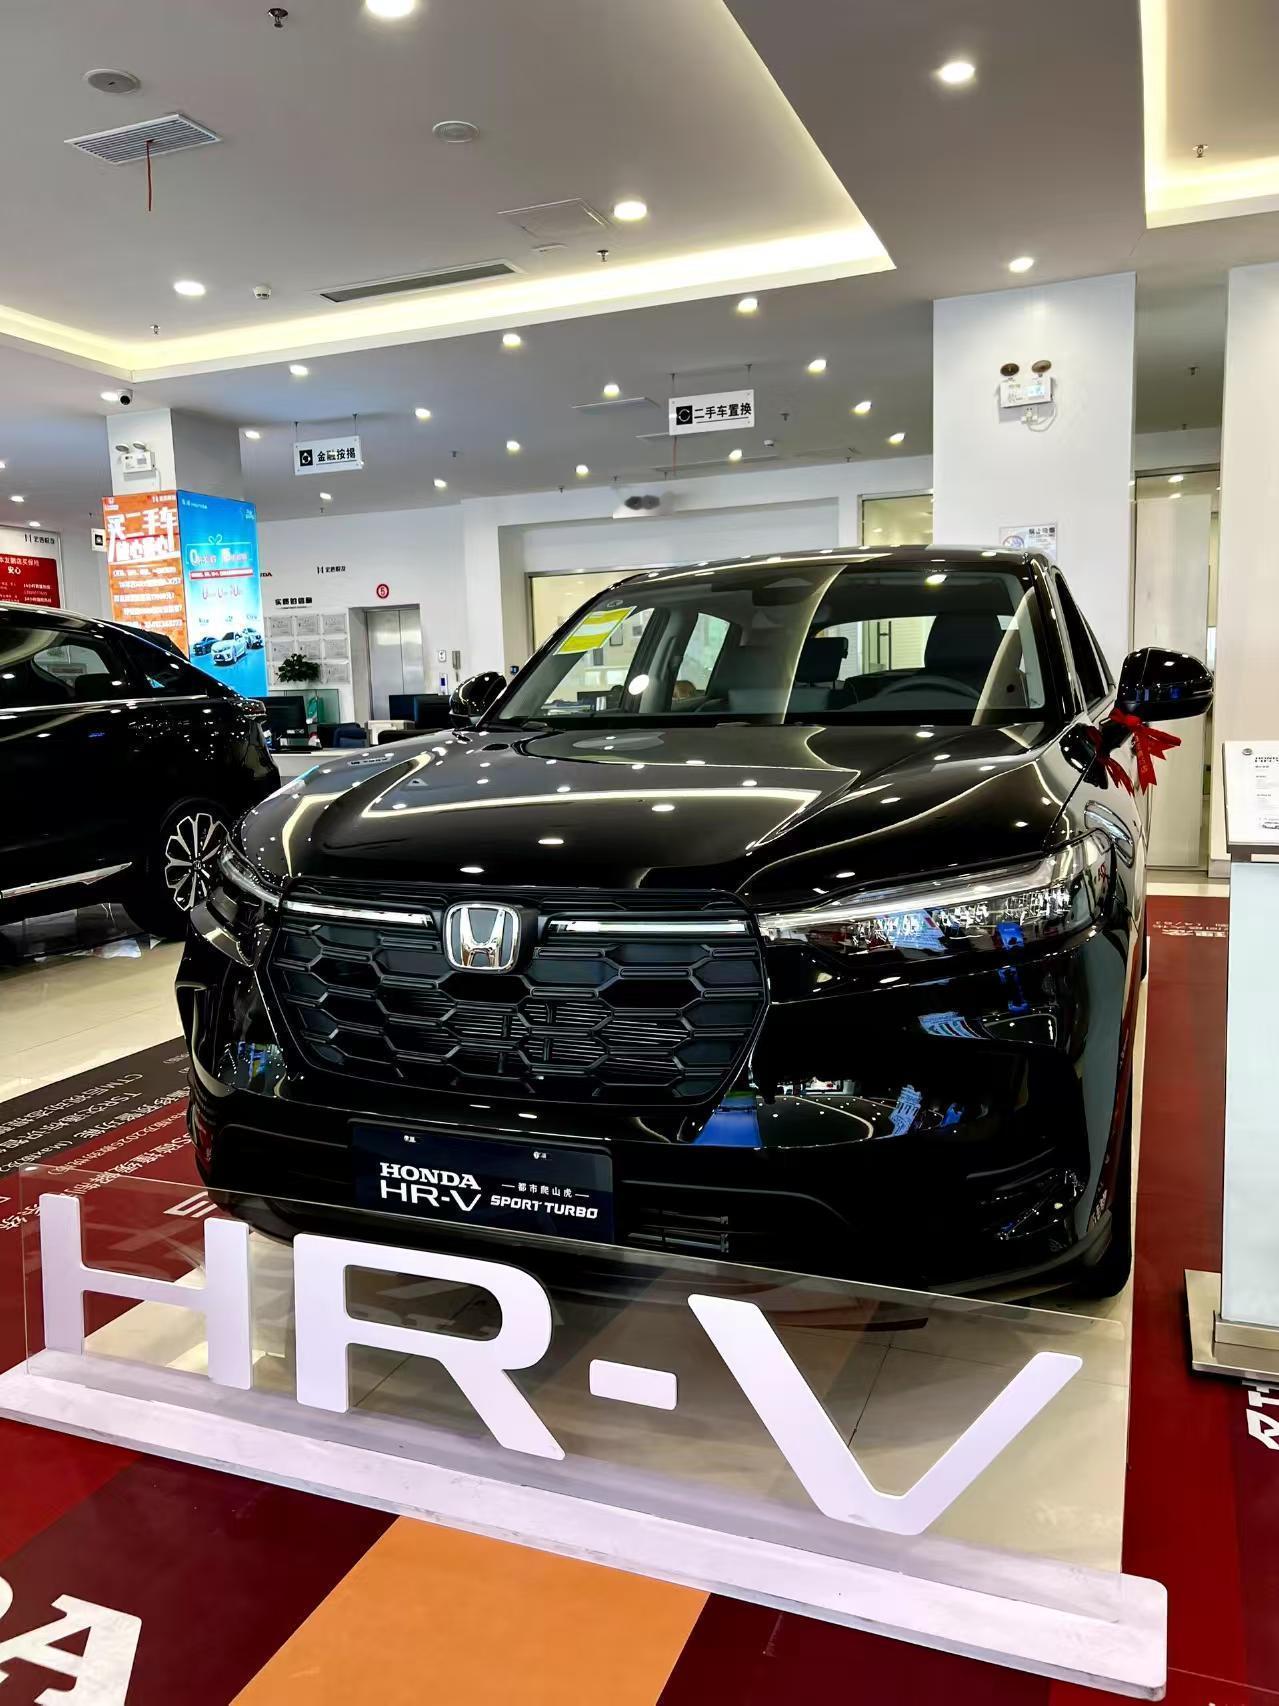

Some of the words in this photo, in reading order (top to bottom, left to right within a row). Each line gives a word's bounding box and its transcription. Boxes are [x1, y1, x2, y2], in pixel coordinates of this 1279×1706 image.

[694, 402, 752, 420] 二手车置换
[0, 1092, 142, 1152] TSR交通标识智
[380, 1162, 481, 1190] HONDA
[381, 1180, 481, 1212] HR-V
[518, 1182, 573, 1199] 都市爬山虎
[490, 1194, 541, 1212] SPORT
[545, 1201, 598, 1219] TURBO
[39, 1193, 1083, 1535] HR-V
